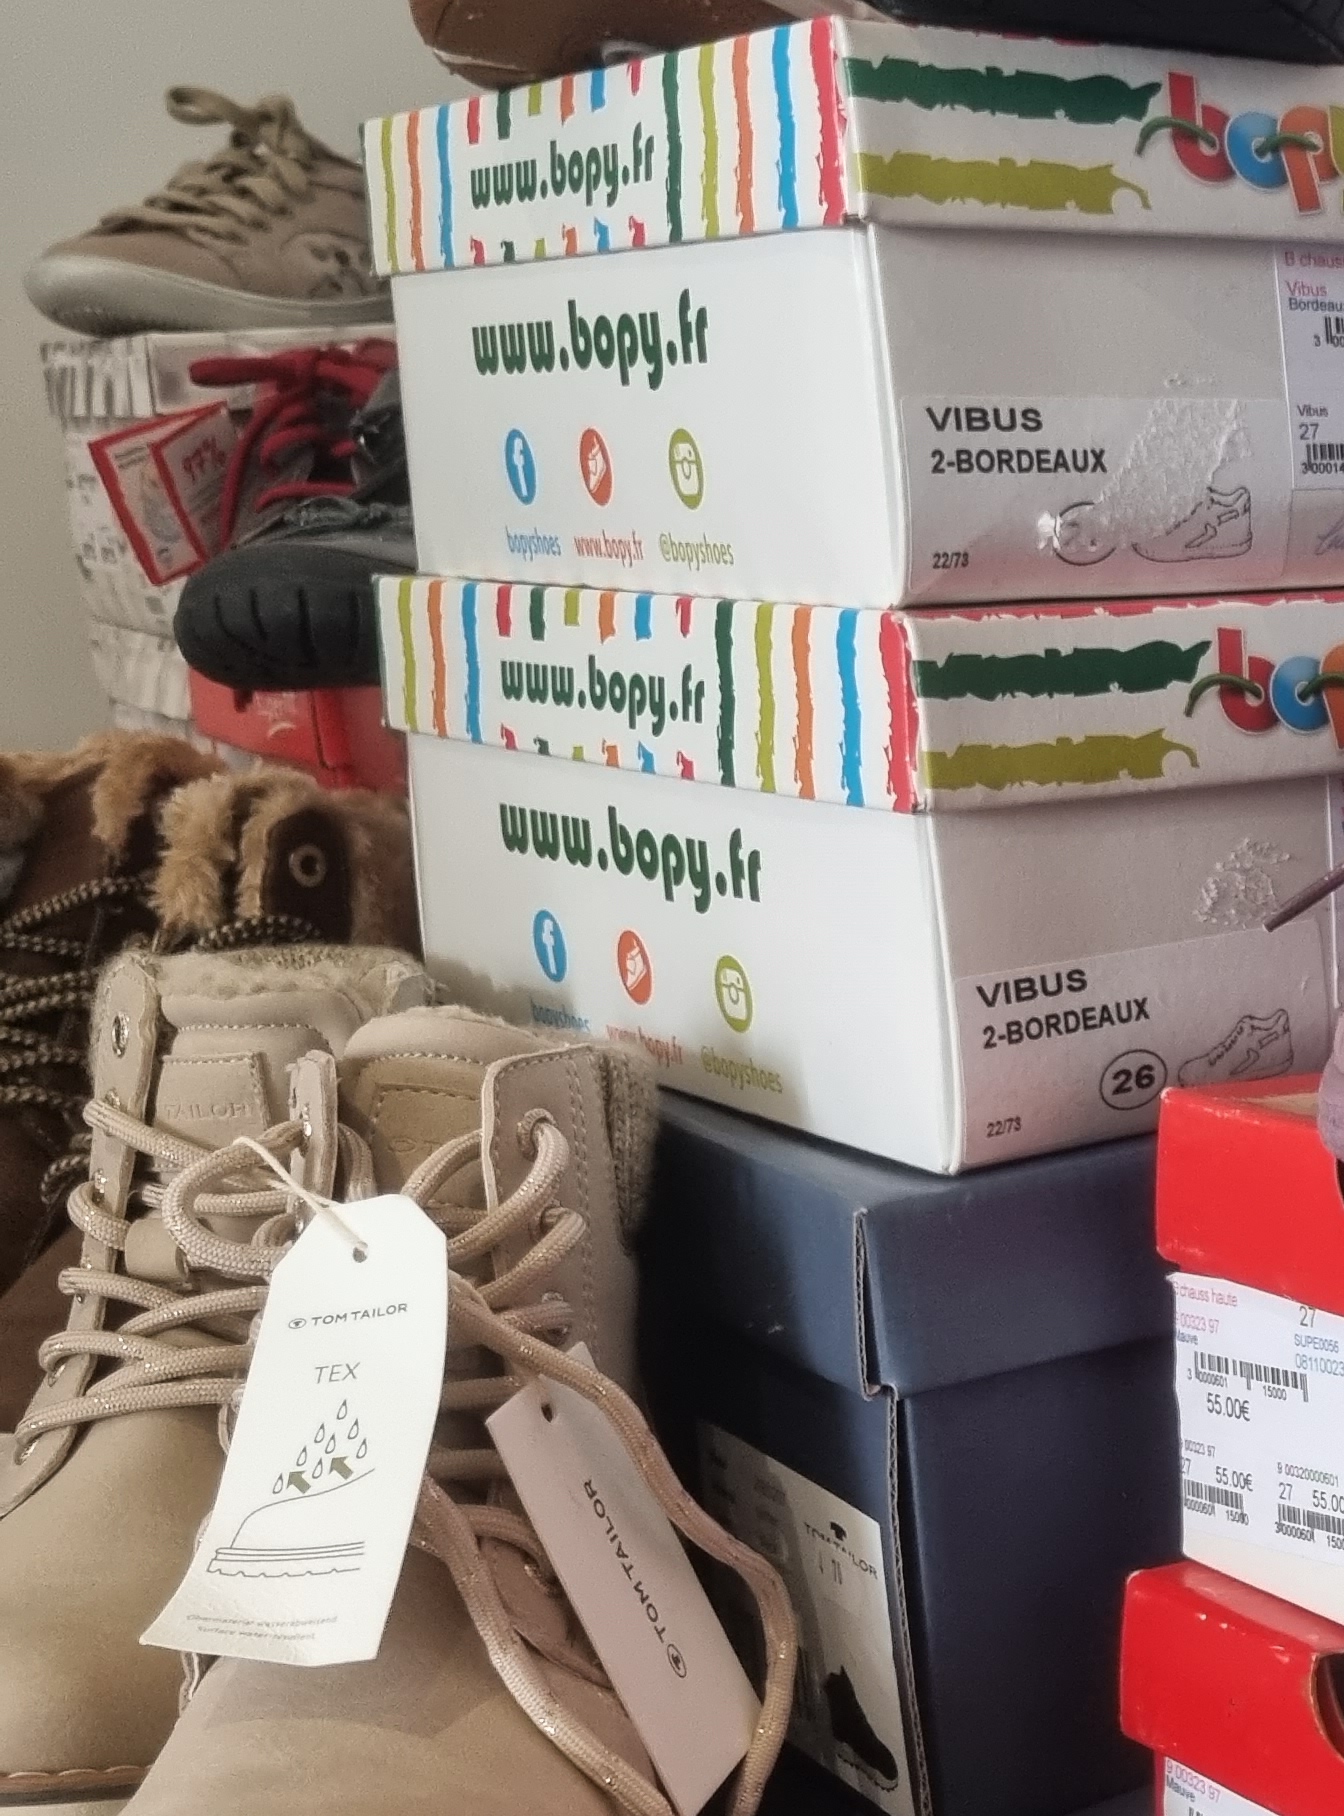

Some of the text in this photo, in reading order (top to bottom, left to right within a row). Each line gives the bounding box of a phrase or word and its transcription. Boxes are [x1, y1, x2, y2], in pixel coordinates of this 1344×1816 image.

[471, 122, 655, 209] www.bopy.fr
[1285, 280, 1328, 297] Vibus
[472, 288, 708, 391] www.bopy.fr
[926, 405, 1044, 433] VIBUS
[1299, 423, 1320, 441] 27
[931, 447, 1108, 474] 2-BORDEAUX
[505, 525, 735, 572] bopyshoes www.bopy.fr @bopyshoes
[932, 551, 970, 569] 22/73
[500, 654, 705, 738] www.bopy.fr
[499, 802, 762, 914] www.bopy.fr
[976, 968, 1088, 1009] VIBUS
[982, 997, 1151, 1050] 2-BORDEAUX
[700, 1046, 783, 1094] @bopyshoes
[1111, 1064, 1156, 1097] 26
[311, 1303, 408, 1326] TOM TAILOR
[1299, 1305, 1317, 1328] 27
[314, 1361, 361, 1384] TEX
[1206, 1391, 1251, 1422] 55.00€
[1262, 1385, 1287, 1401] 15000
[1215, 1465, 1253, 1492] 55.00€
[1278, 1482, 1294, 1501] 27
[583, 1479, 667, 1644] TOM TAILOR
